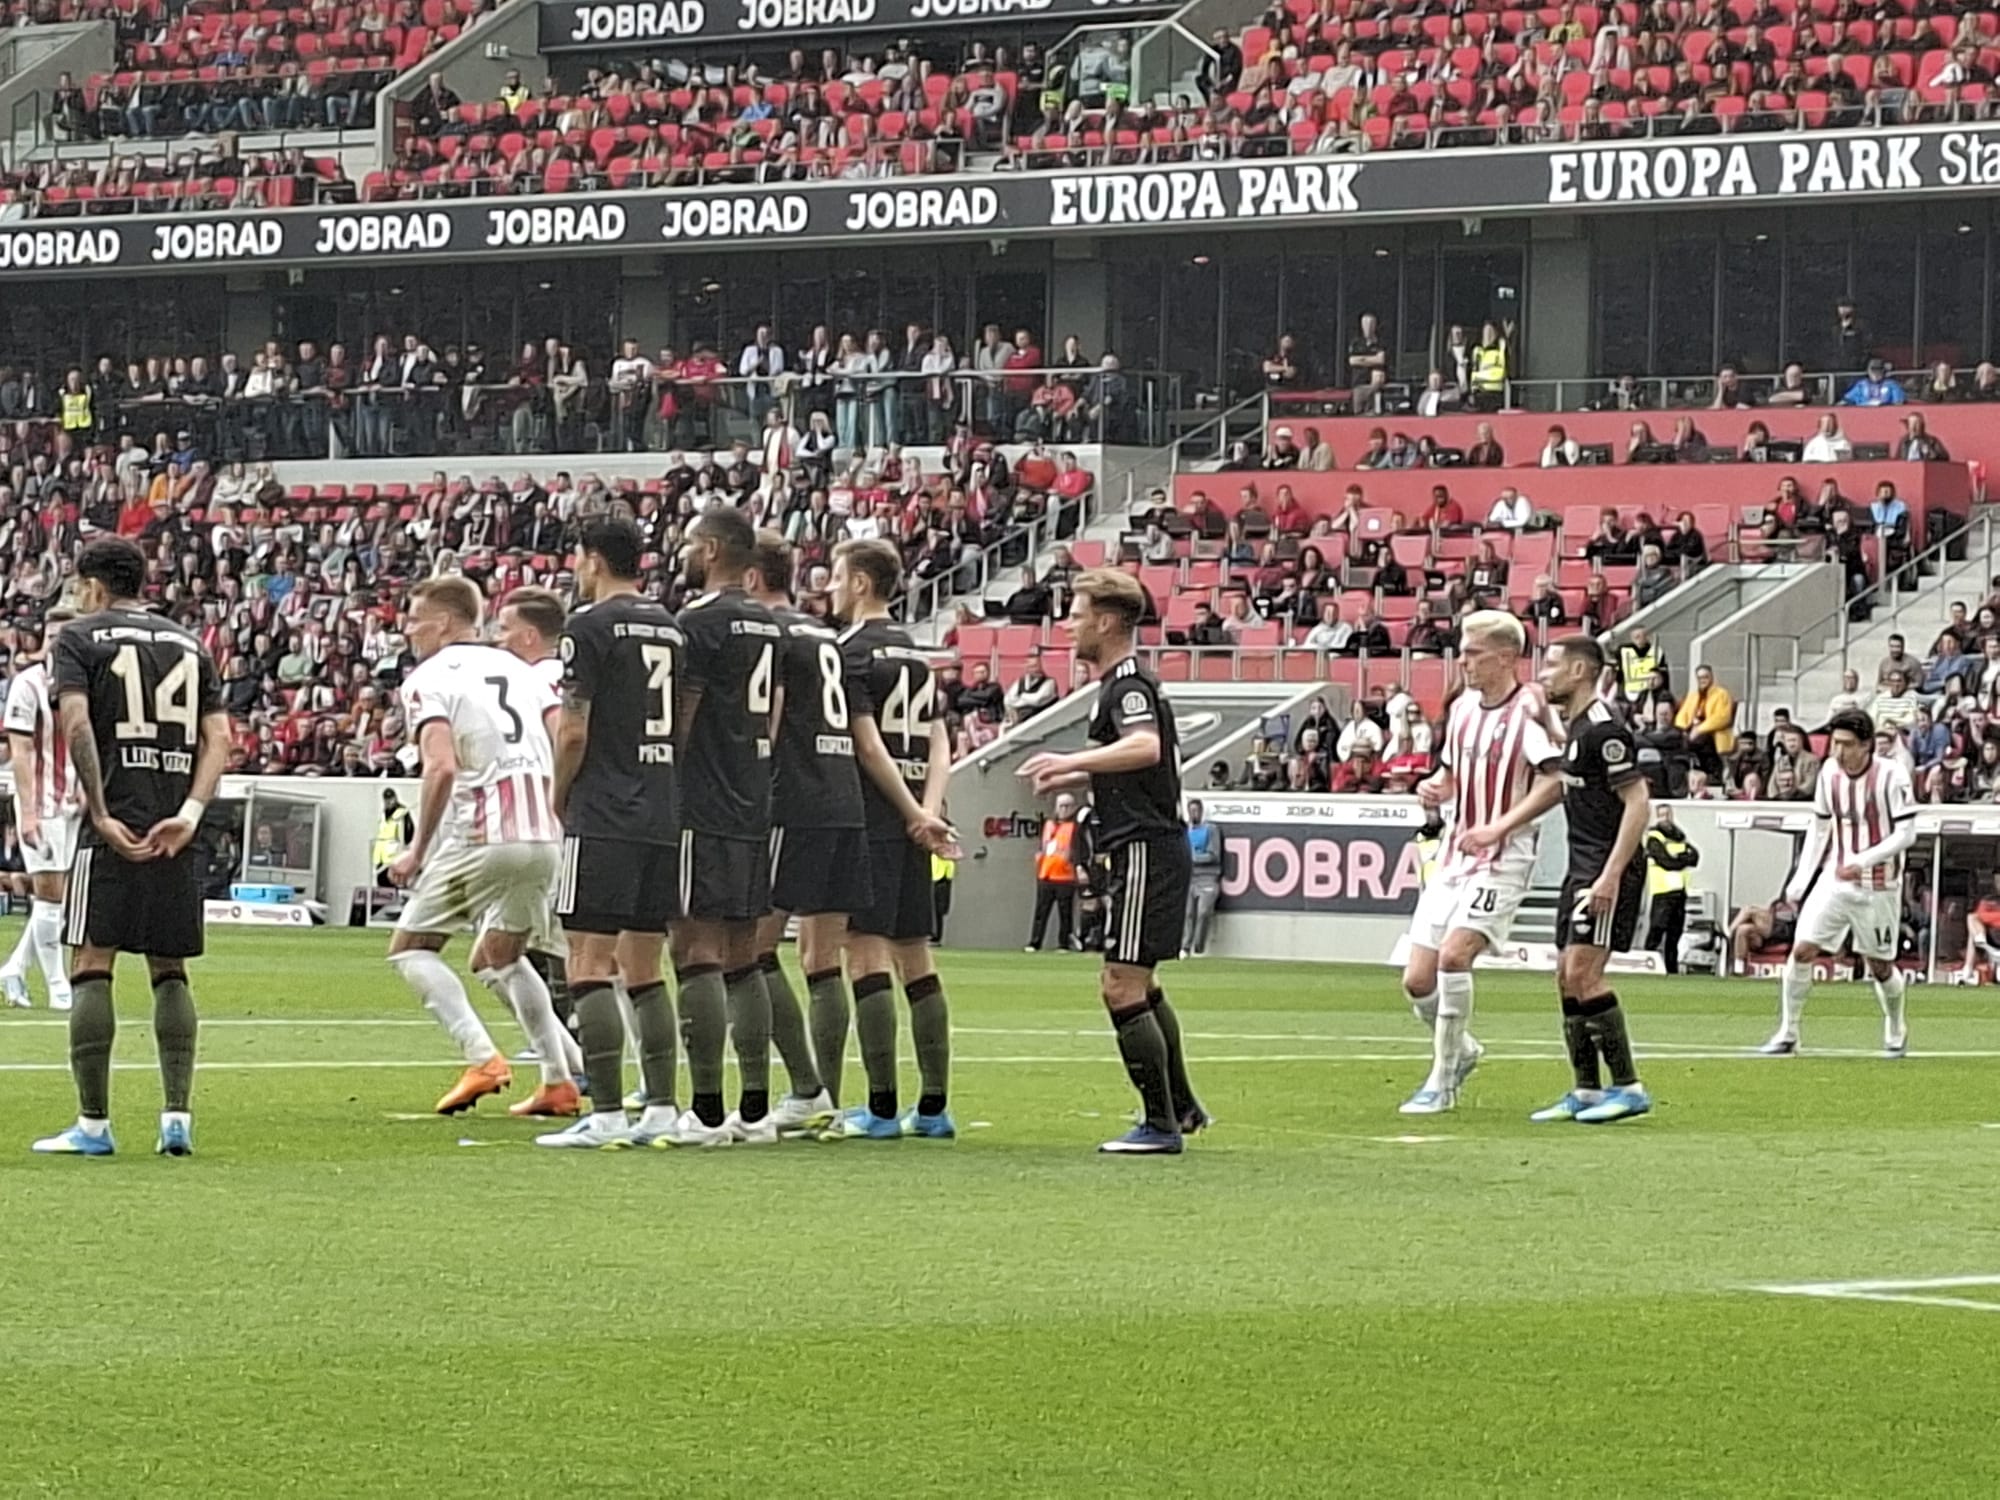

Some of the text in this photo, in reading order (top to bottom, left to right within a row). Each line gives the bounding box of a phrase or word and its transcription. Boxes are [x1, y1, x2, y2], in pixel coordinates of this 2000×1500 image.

[571, 0, 704, 41] JOBRAD
[738, 0, 876, 29] JOBRAD
[1050, 162, 1365, 225] EUROPA PARK
[1548, 132, 2000, 202] EUROPA PARK Sta
[0, 187, 999, 267] JOBRAD JOBRAD JOBRAD JOBRAD JOBRAD JOBRAD
[110, 643, 200, 745] 14
[484, 676, 524, 744] 3
[641, 643, 674, 737] 3
[748, 643, 774, 713] 4
[818, 642, 849, 729] 8
[881, 665, 937, 753] 44
[1221, 837, 1423, 900] JOBRA
[1470, 886, 1497, 913] 28
[1874, 926, 1892, 946] 14
